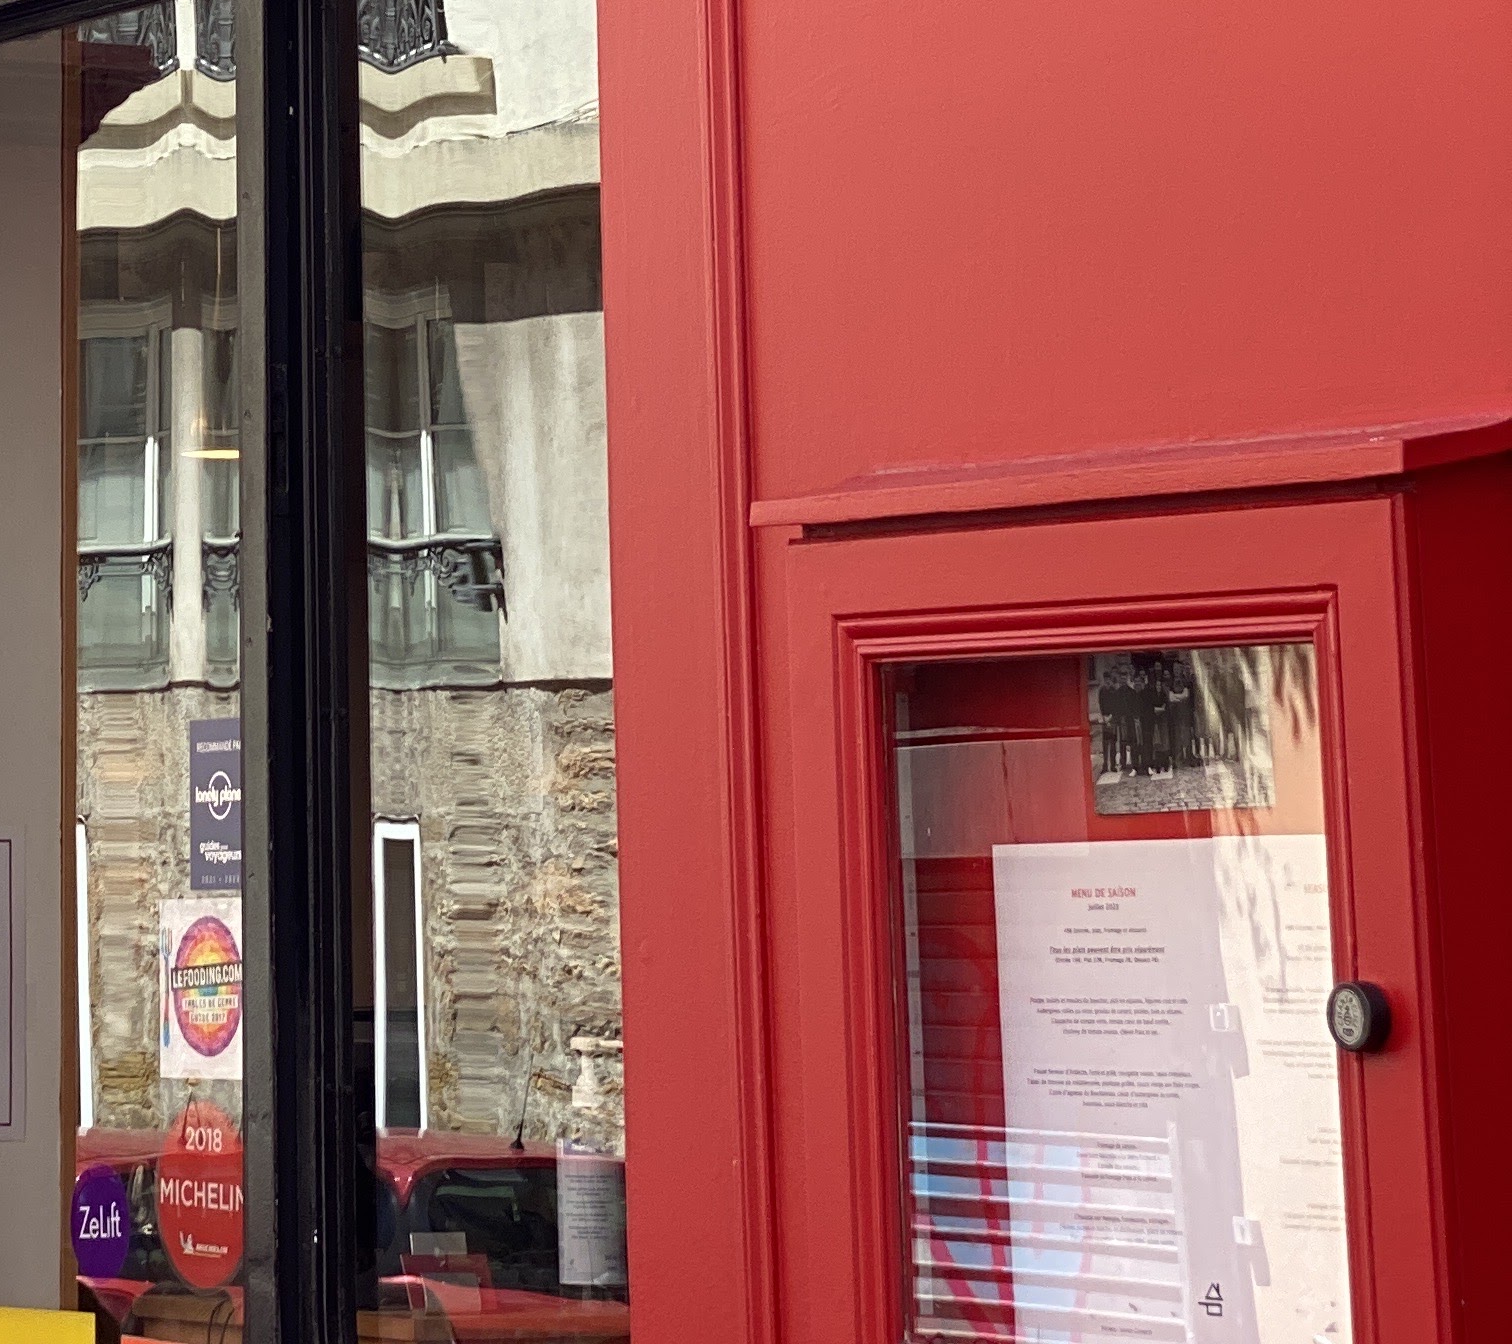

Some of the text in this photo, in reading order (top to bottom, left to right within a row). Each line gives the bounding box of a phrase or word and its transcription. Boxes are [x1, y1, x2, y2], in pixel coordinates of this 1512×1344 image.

[196, 786, 218, 807] lonely
[1071, 889, 1092, 898] MENU
[1095, 889, 1105, 898] DE
[185, 1126, 222, 1152] 2018
[79, 1201, 122, 1239] ZeLift
